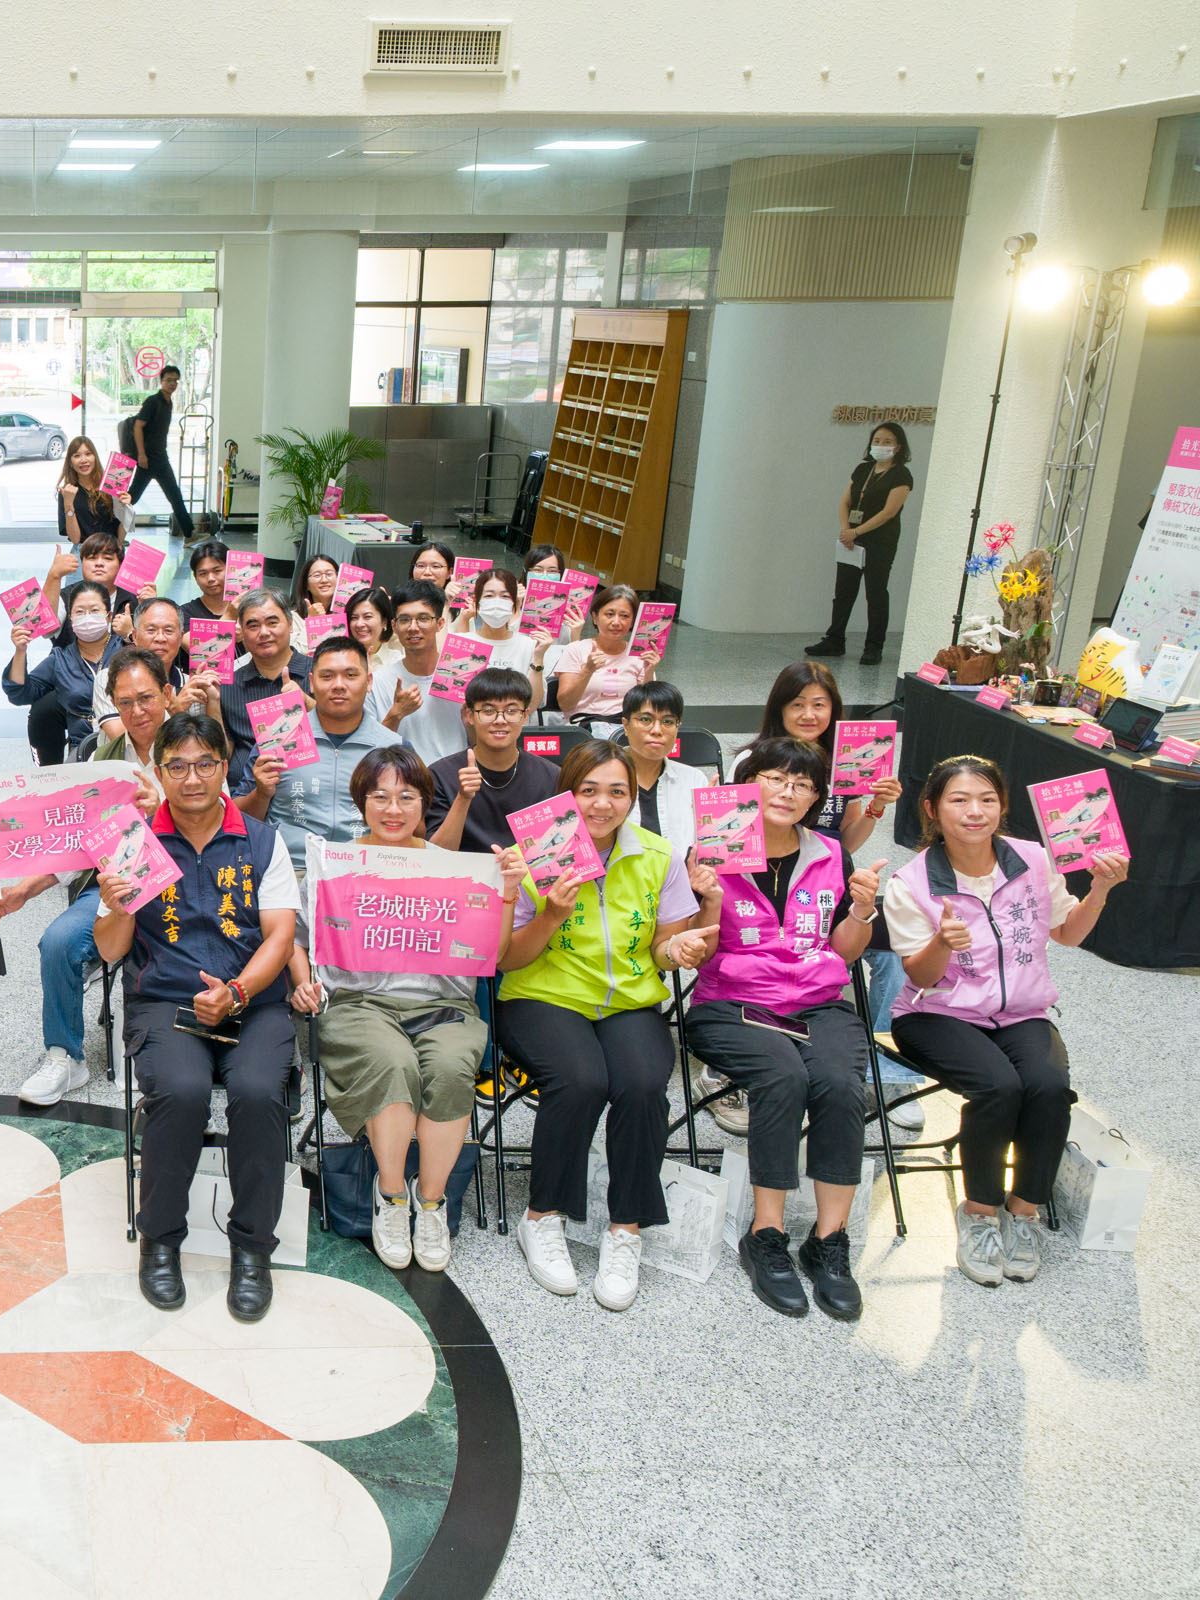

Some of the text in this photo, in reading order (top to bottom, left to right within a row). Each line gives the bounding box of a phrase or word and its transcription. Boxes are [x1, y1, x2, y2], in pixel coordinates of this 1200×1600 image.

[526, 740, 558, 752] 貴賓席
[15, 775, 27, 788] 5
[1040, 780, 1083, 797] 拾光之城
[699, 790, 737, 801] 拾光之城
[44, 803, 86, 829] 見證
[513, 805, 551, 826] 拾光之城
[1, 830, 86, 861] 文學之城
[325, 849, 368, 866] Route 1
[376, 852, 408, 862] Exploring
[240, 864, 253, 909] 市議員
[161, 882, 182, 944] 陳文吉
[217, 865, 242, 939] 陳美梅
[352, 892, 457, 924] 老城時光
[575, 902, 585, 926] 助理
[1025, 885, 1038, 922] 市議員
[734, 900, 762, 945] 秘書
[1008, 902, 1034, 967] 黃婉如
[363, 924, 442, 953] 的印記
